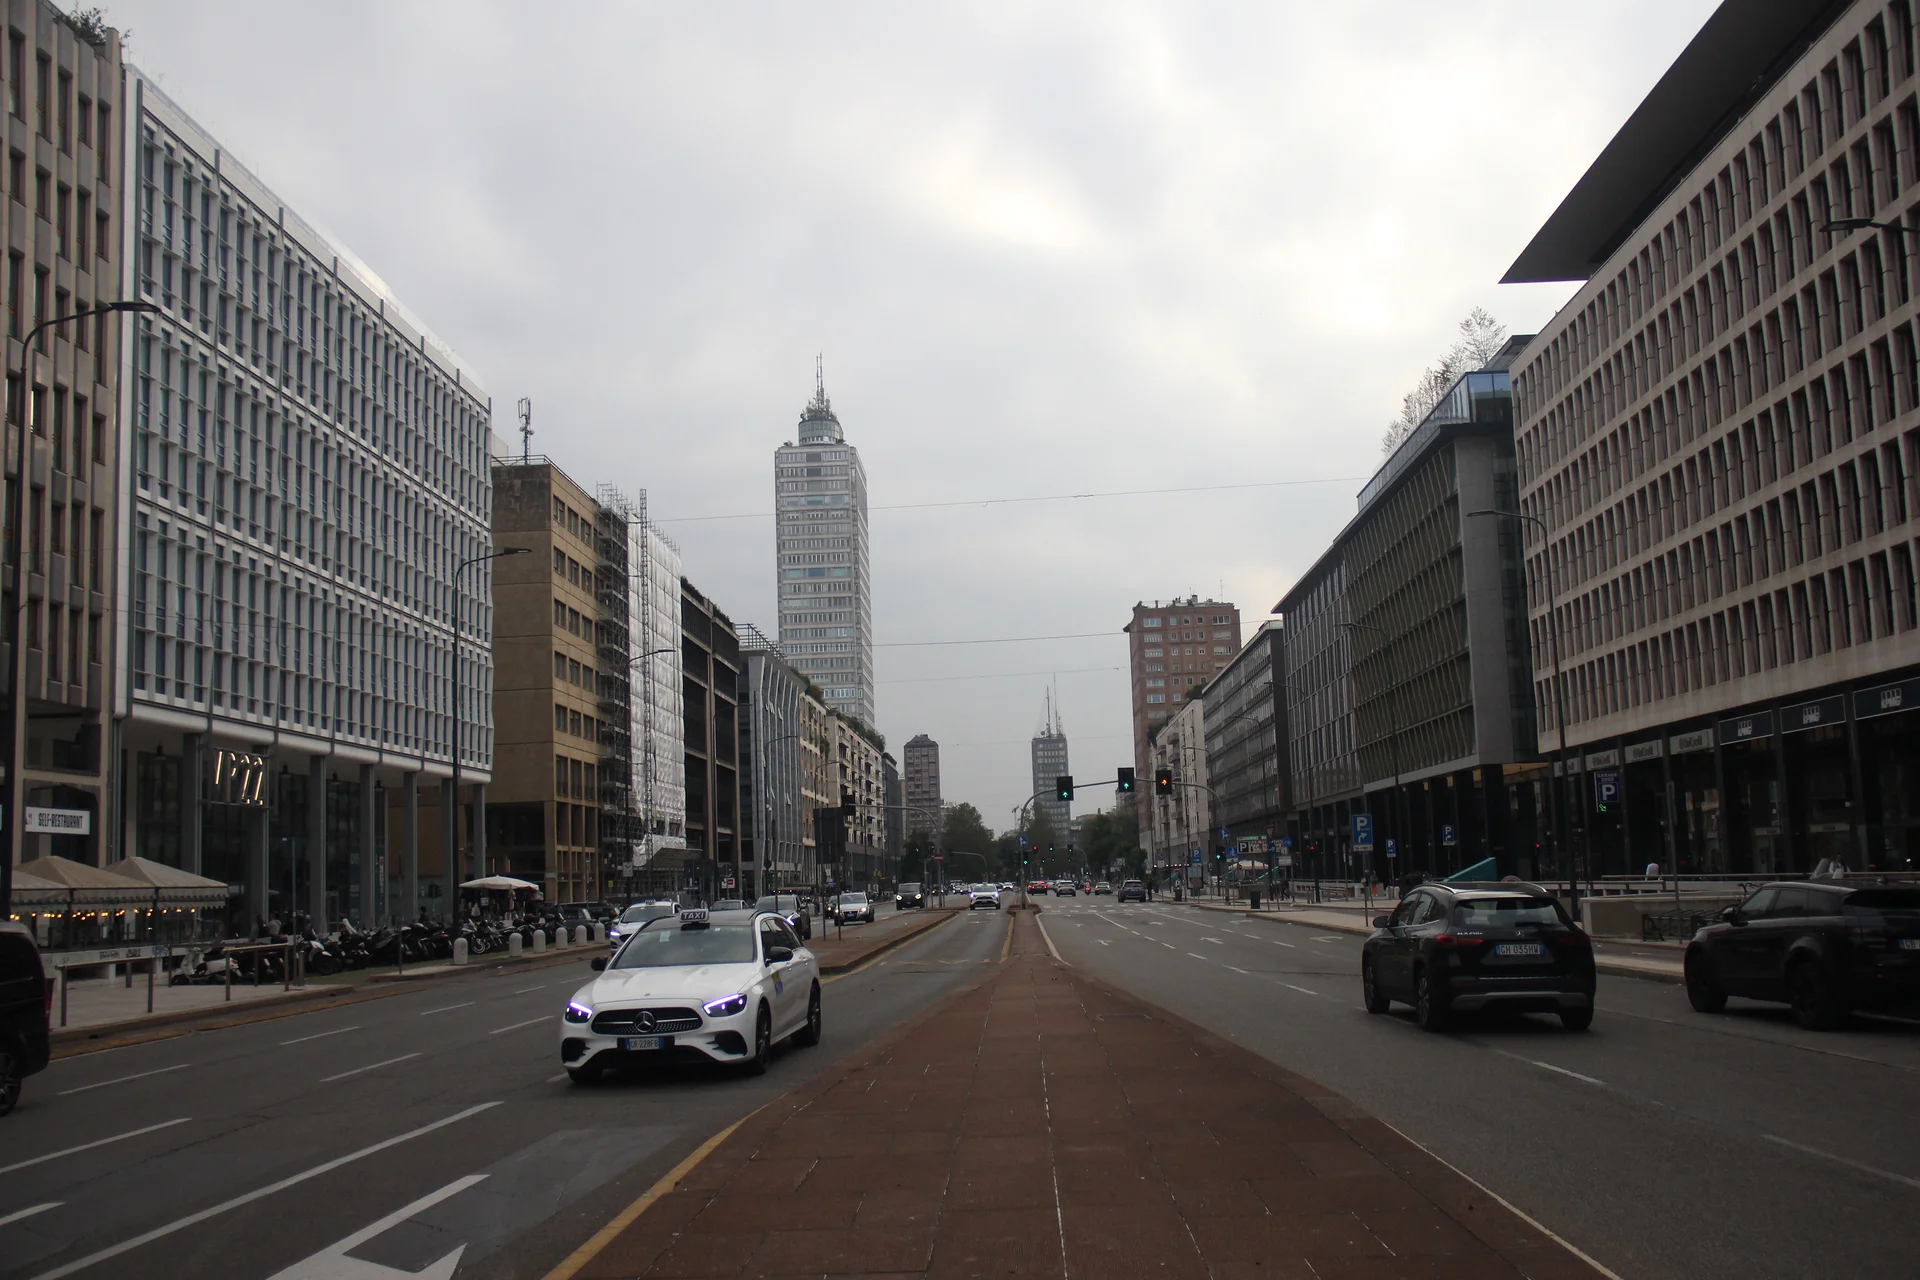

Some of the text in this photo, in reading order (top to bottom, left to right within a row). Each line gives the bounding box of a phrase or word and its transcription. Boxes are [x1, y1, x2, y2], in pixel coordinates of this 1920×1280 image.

[1880, 689, 1903, 709] KPMG
[1601, 784, 1616, 801] P
[1356, 816, 1368, 832] P
[1445, 826, 1452, 835] P
[1239, 842, 1248, 852] P
[1387, 840, 1394, 848] P
[1193, 849, 1200, 857] P
[682, 911, 705, 920] TAXI
